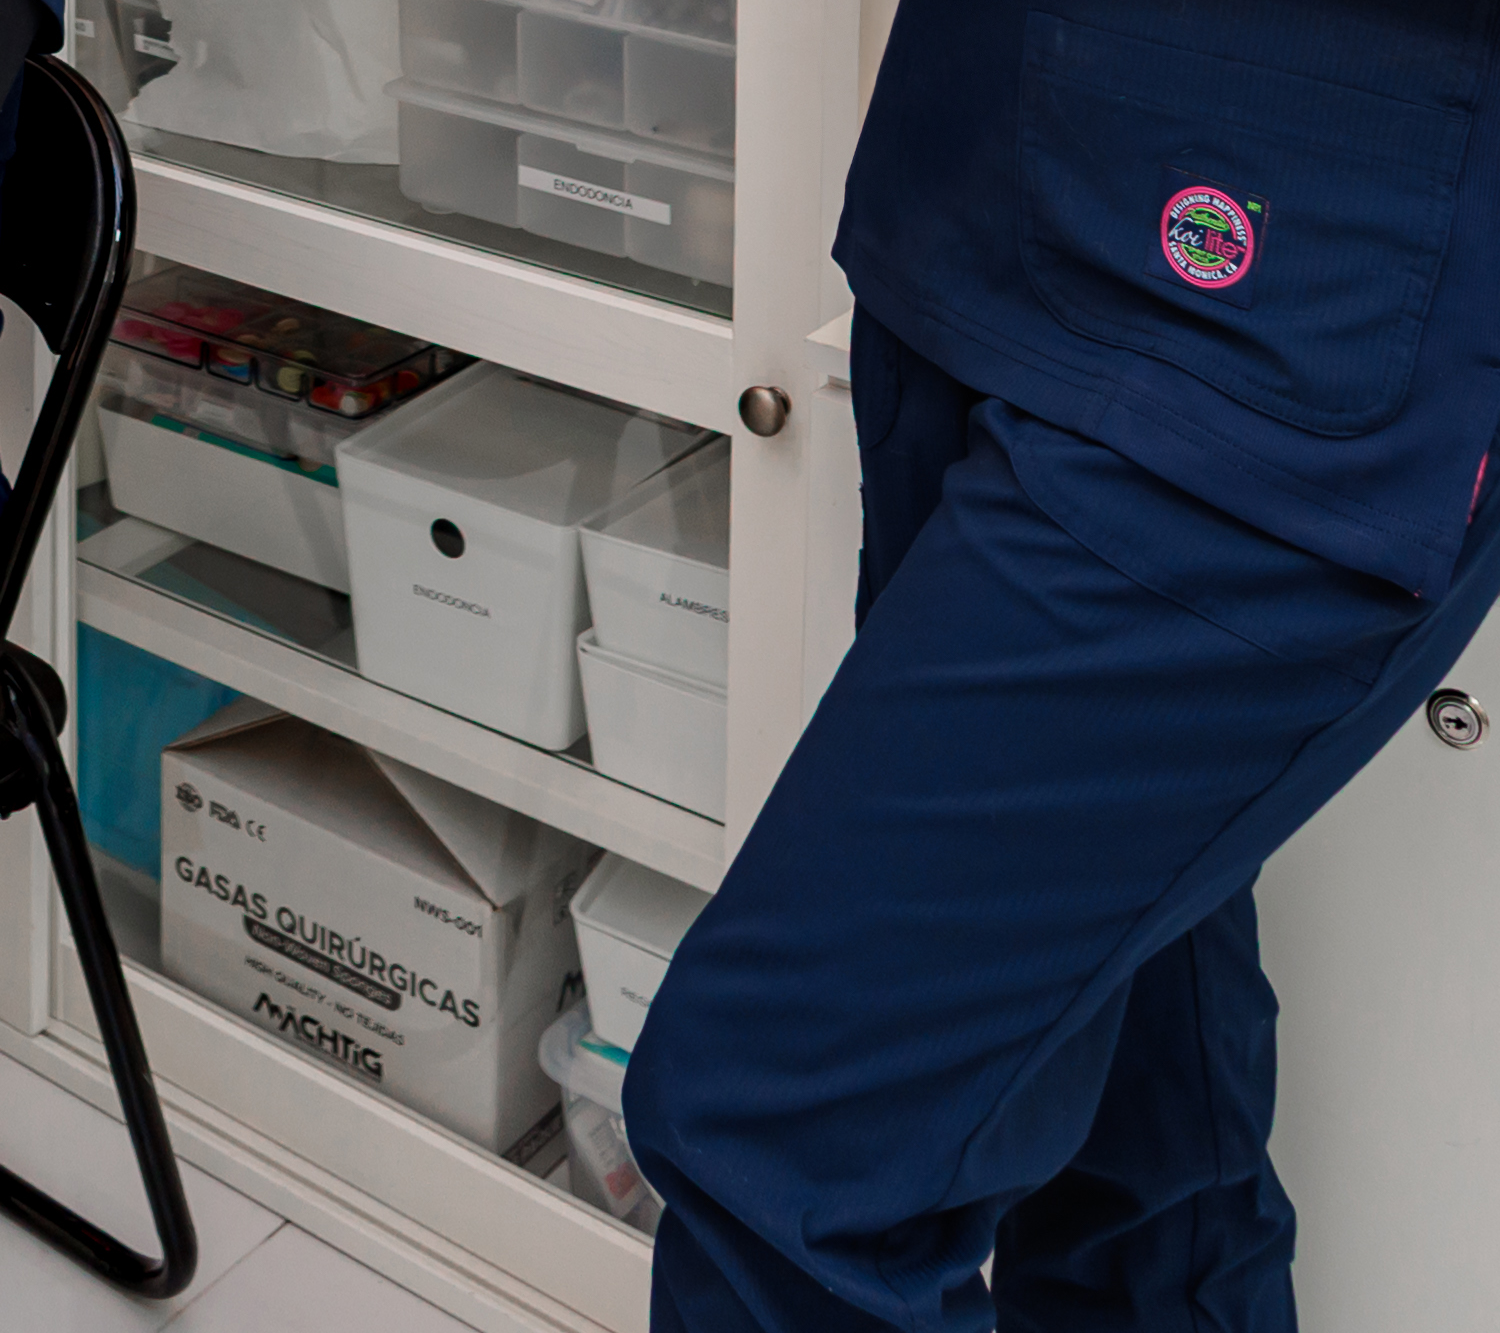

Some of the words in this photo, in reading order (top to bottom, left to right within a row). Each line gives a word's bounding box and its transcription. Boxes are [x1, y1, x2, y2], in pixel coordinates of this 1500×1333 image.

[552, 178, 634, 212] ENDODONCIA
[1168, 216, 1204, 247] koi
[1204, 228, 1238, 260] lite
[1169, 194, 1211, 220] DESIGNING
[1211, 197, 1248, 242] HAPPINESS
[1168, 240, 1188, 269] SANTA
[1225, 262, 1238, 274] CA
[412, 583, 493, 619] ENDODONCIA
[208, 800, 241, 830] FDA
[174, 855, 268, 920] GASAS
[276, 906, 481, 1029] QUIRÚRGICAS
[274, 970, 327, 1004] QUALITY
[355, 1011, 406, 1047] TEJIDAS
